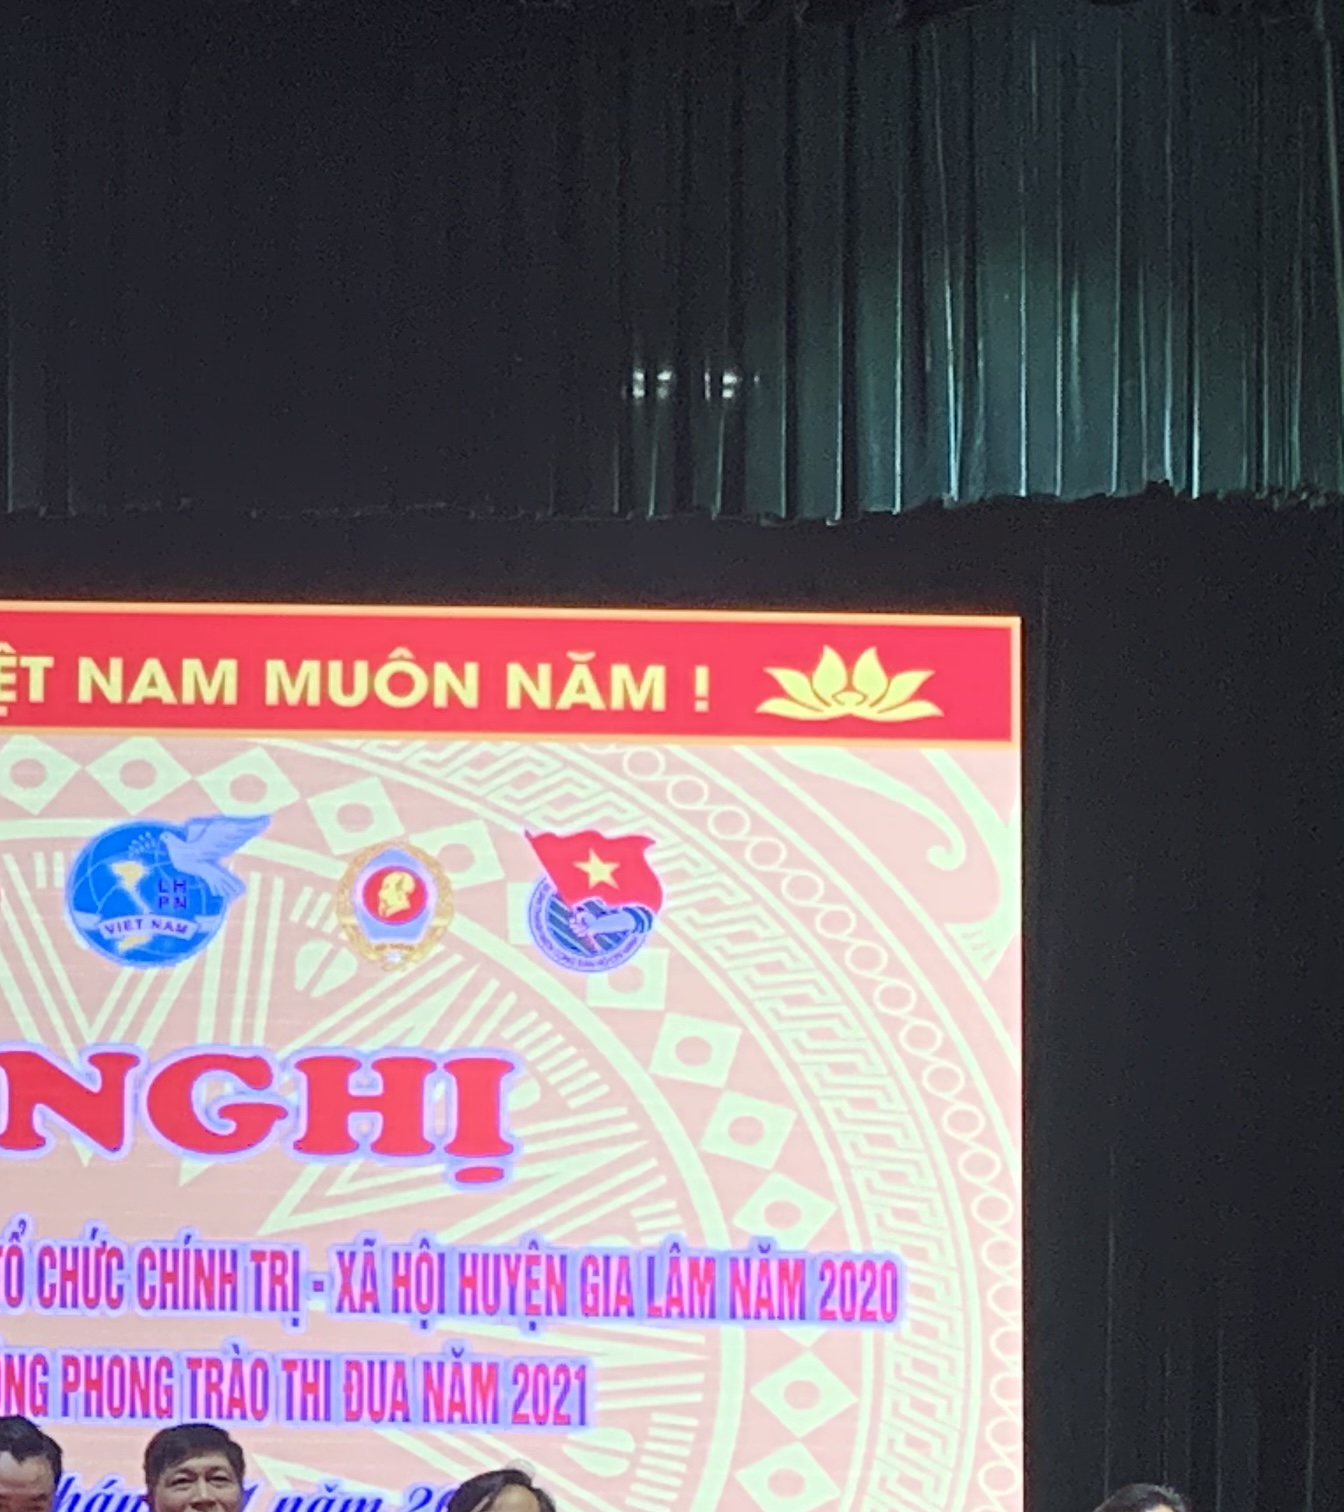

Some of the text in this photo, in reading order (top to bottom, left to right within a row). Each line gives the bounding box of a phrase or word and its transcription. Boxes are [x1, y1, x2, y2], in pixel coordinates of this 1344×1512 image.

[79, 657, 237, 705] NAM
[265, 647, 478, 709] MUÔN
[507, 651, 667, 712] NĂM
[37, 1226, 126, 1311] CHỨC
[137, 1233, 239, 1313] CHÍNH
[250, 1249, 300, 1328] TRỊ
[335, 1237, 381, 1315] XÃ
[392, 1237, 445, 1330] HỘI
[459, 1239, 567, 1331] HUYỆN
[580, 1253, 635, 1319] GIA
[647, 1242, 716, 1320] LÂM
[729, 1244, 806, 1321] NĂM
[819, 1259, 899, 1322] 2020
[62, 1354, 174, 1421] PHONG
[187, 1344, 269, 1422] TRÀO
[282, 1359, 332, 1422] THI
[344, 1361, 412, 1423] ĐUA
[423, 1352, 500, 1425] NĂM
[513, 1363, 588, 1426] 2021
